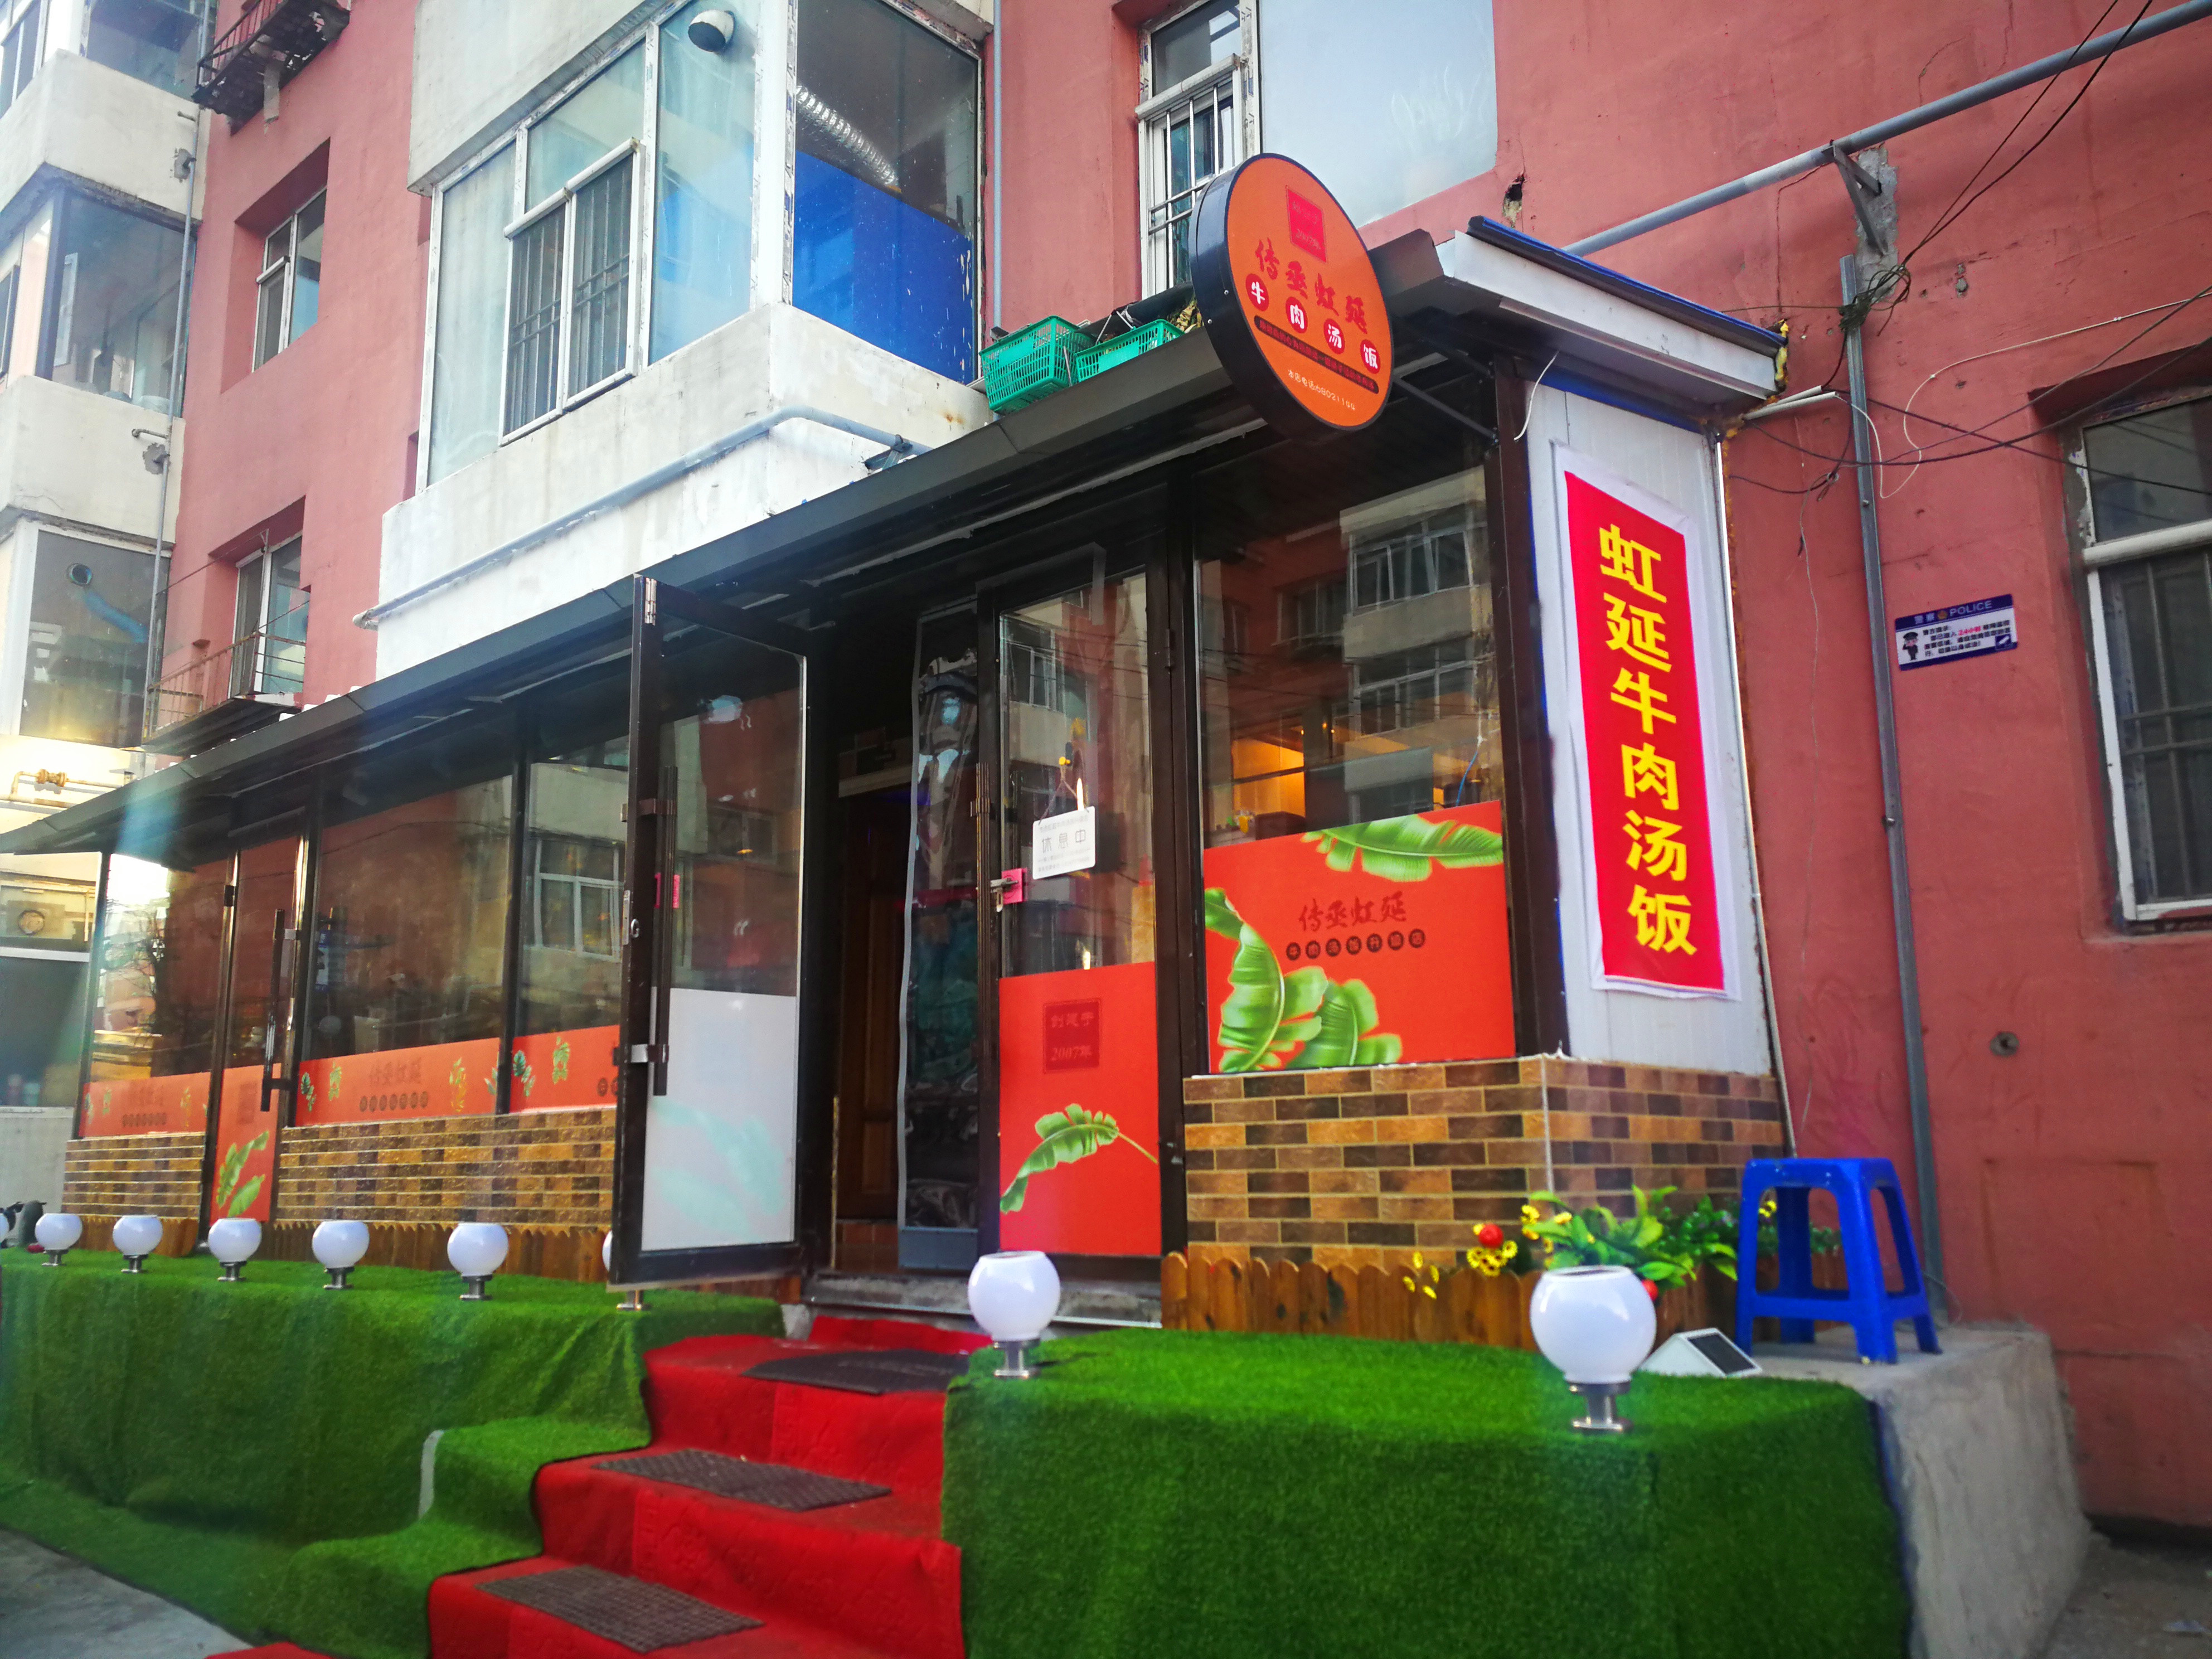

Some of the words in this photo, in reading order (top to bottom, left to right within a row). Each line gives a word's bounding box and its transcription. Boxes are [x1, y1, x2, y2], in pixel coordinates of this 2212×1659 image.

[1250, 280, 1379, 369] 牛肉汤饭
[1949, 600, 1993, 617] POLICE
[1599, 523, 1697, 955] 虹延牛肉汤饭
[1041, 828, 1086, 853] 休息中
